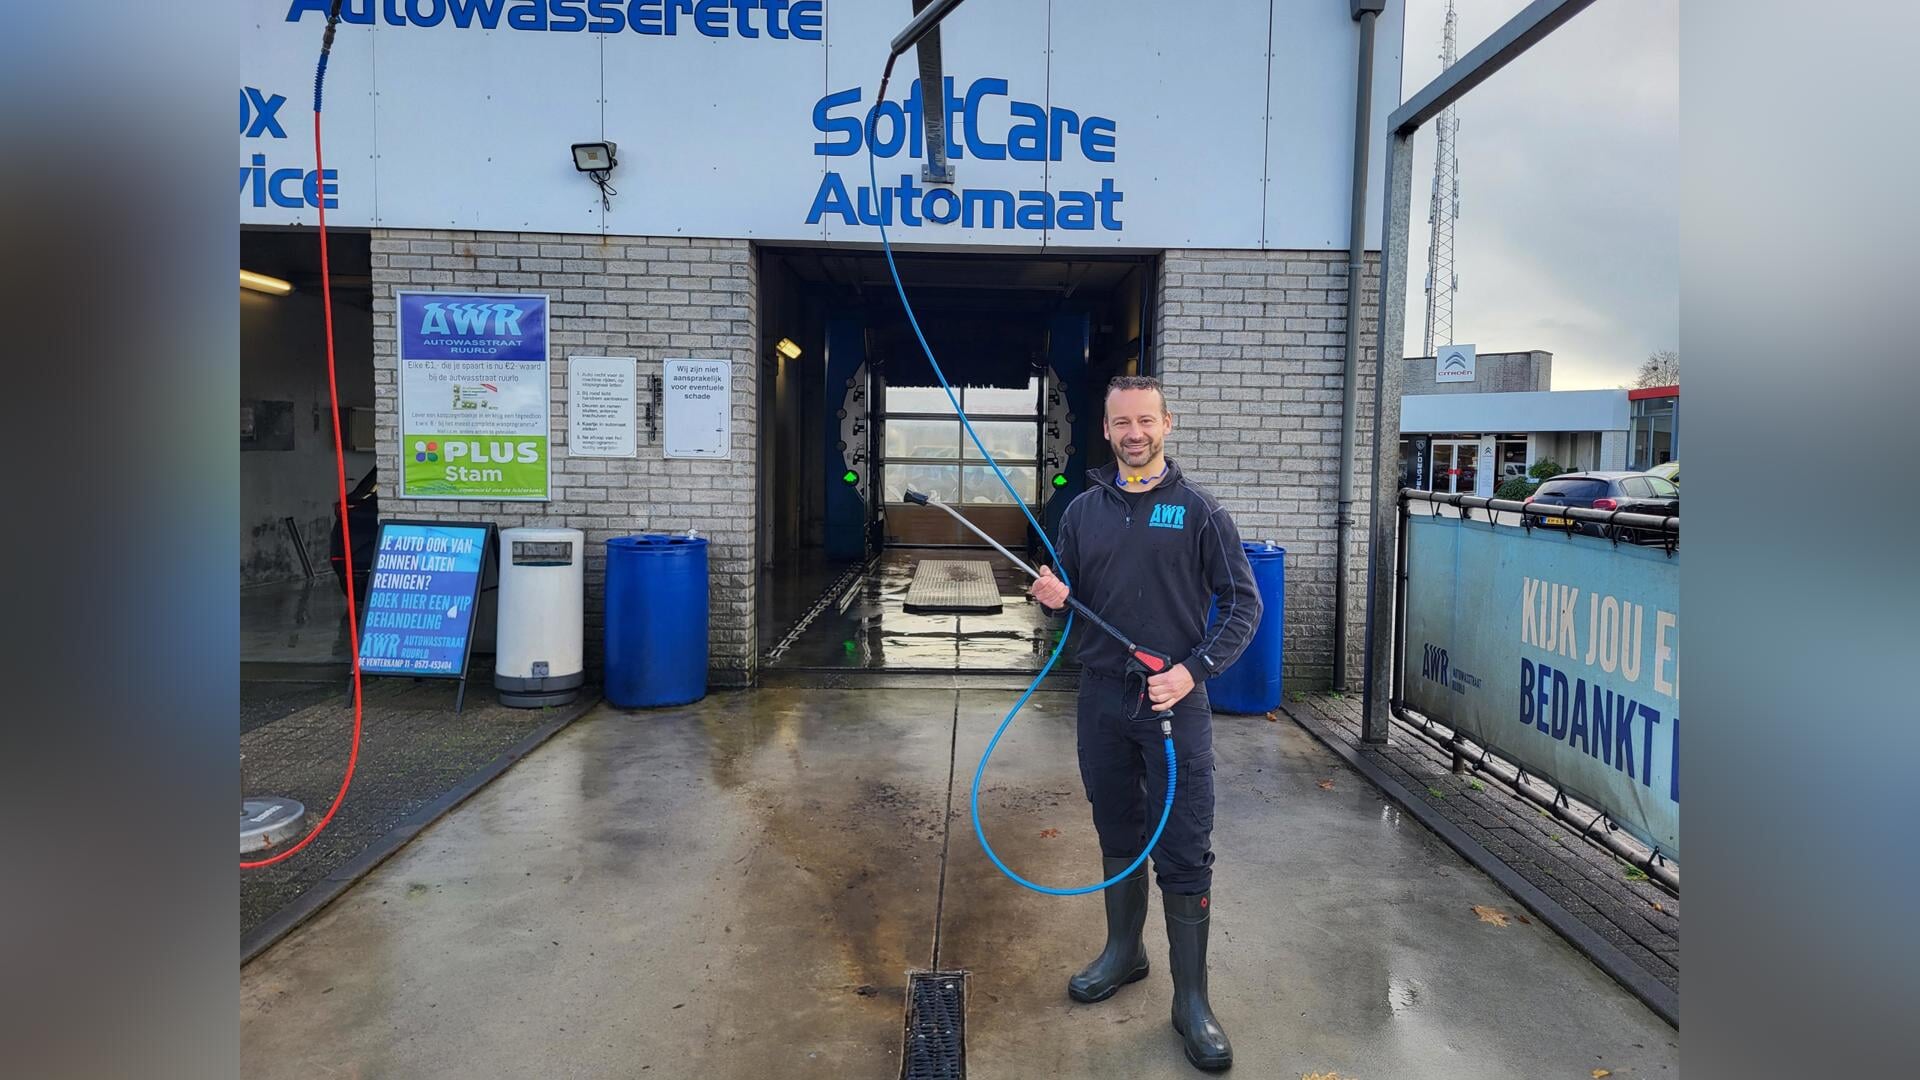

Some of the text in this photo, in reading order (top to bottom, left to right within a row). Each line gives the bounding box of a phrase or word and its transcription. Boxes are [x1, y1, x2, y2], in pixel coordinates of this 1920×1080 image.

[240, 86, 288, 139] x
[812, 76, 1116, 163] SoftCare
[804, 170, 1124, 231] Automaat
[420, 302, 525, 336] AWR
[423, 339, 524, 347] AUTOWASSTRAAT
[450, 347, 497, 355] RUURLO
[462, 362, 484, 371] spaart
[520, 363, 541, 371] waard
[676, 365, 719, 374] Wij zijn niet
[673, 375, 722, 383] aansprakelijk
[444, 441, 539, 464] PLUS
[445, 466, 503, 482] Stam
[1150, 503, 1186, 525] AWR
[379, 535, 473, 554] JE AUTO OOK VAN
[376, 554, 456, 573] BINNEN LATEN
[373, 573, 433, 591] REINIGEN?
[369, 591, 473, 612] BOEK HIER EEN VIP
[365, 611, 444, 630] BEHANDELING
[359, 632, 401, 658] AWR
[403, 635, 465, 649] AUTOWASSTRAAT
[1521, 576, 1679, 700] KIJK JOU E
[401, 647, 430, 660] RUURLO
[1422, 642, 1449, 688] AWR
[1519, 657, 1661, 788] BEDANKT
